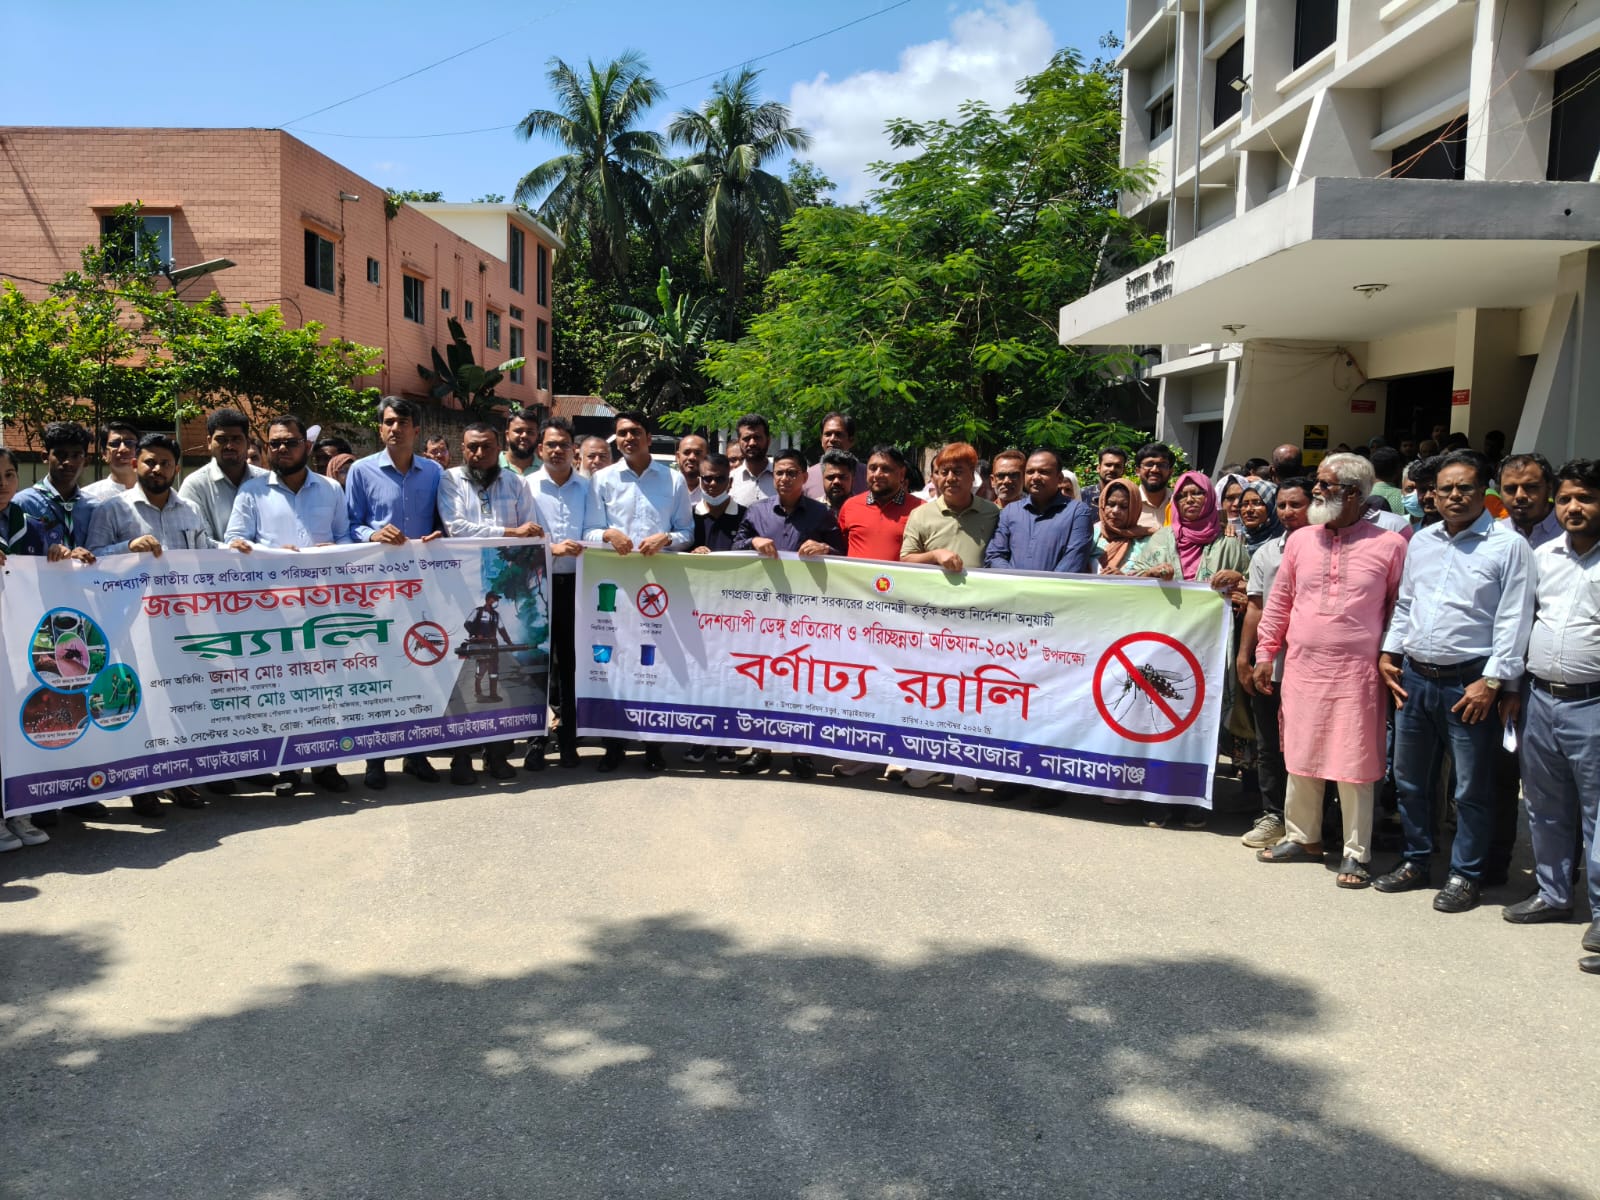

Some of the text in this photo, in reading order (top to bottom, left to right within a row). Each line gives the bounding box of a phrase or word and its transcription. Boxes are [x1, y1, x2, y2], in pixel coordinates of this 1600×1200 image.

[153, 571, 189, 586] জাতীয়
[193, 572, 216, 586] ডেঙ্গু
[218, 569, 263, 582] প্রতিরোধ
[267, 570, 277, 580] ও
[281, 566, 331, 579] পরিচ্ছন্নতা
[335, 562, 375, 576] অভিযান
[142, 579, 423, 617] জনসচেতনতামূলক
[821, 596, 863, 610] সরকারের
[866, 600, 907, 615] প্রধানমন্ত্রী
[911, 603, 938, 620] কর্তৃক
[941, 607, 965, 619] প্রদত্ত
[969, 606, 1011, 625] নির্দেশনা
[1016, 611, 1056, 628] অনুযায়ী
[760, 617, 787, 640] ডেঙ্গু
[790, 614, 842, 641] প্রতিরোধ
[847, 626, 857, 641] ও
[862, 621, 923, 649] পরিচ্ছন্নতা
[150, 678, 172, 689] প্রধান
[208, 667, 249, 685] জনাব
[255, 664, 283, 680] মোঃ
[288, 658, 337, 677] রায়হান
[342, 652, 379, 671] কবির
[729, 643, 879, 701] বর্ণাঢ্য
[209, 694, 251, 711] জনাব
[257, 691, 286, 708] মোঃ
[290, 684, 344, 702] আসাদুর
[348, 679, 393, 696] রহমান
[232, 726, 259, 737] ২০২৬
[367, 709, 391, 718] সকাল
[409, 703, 433, 714] ঘটিকা
[355, 729, 405, 749] আড়াইহাজার
[736, 710, 815, 741] উপজেলা
[1039, 751, 1146, 785] নারায়ণগঞ্জ
[108, 764, 149, 784] উপজেলা
